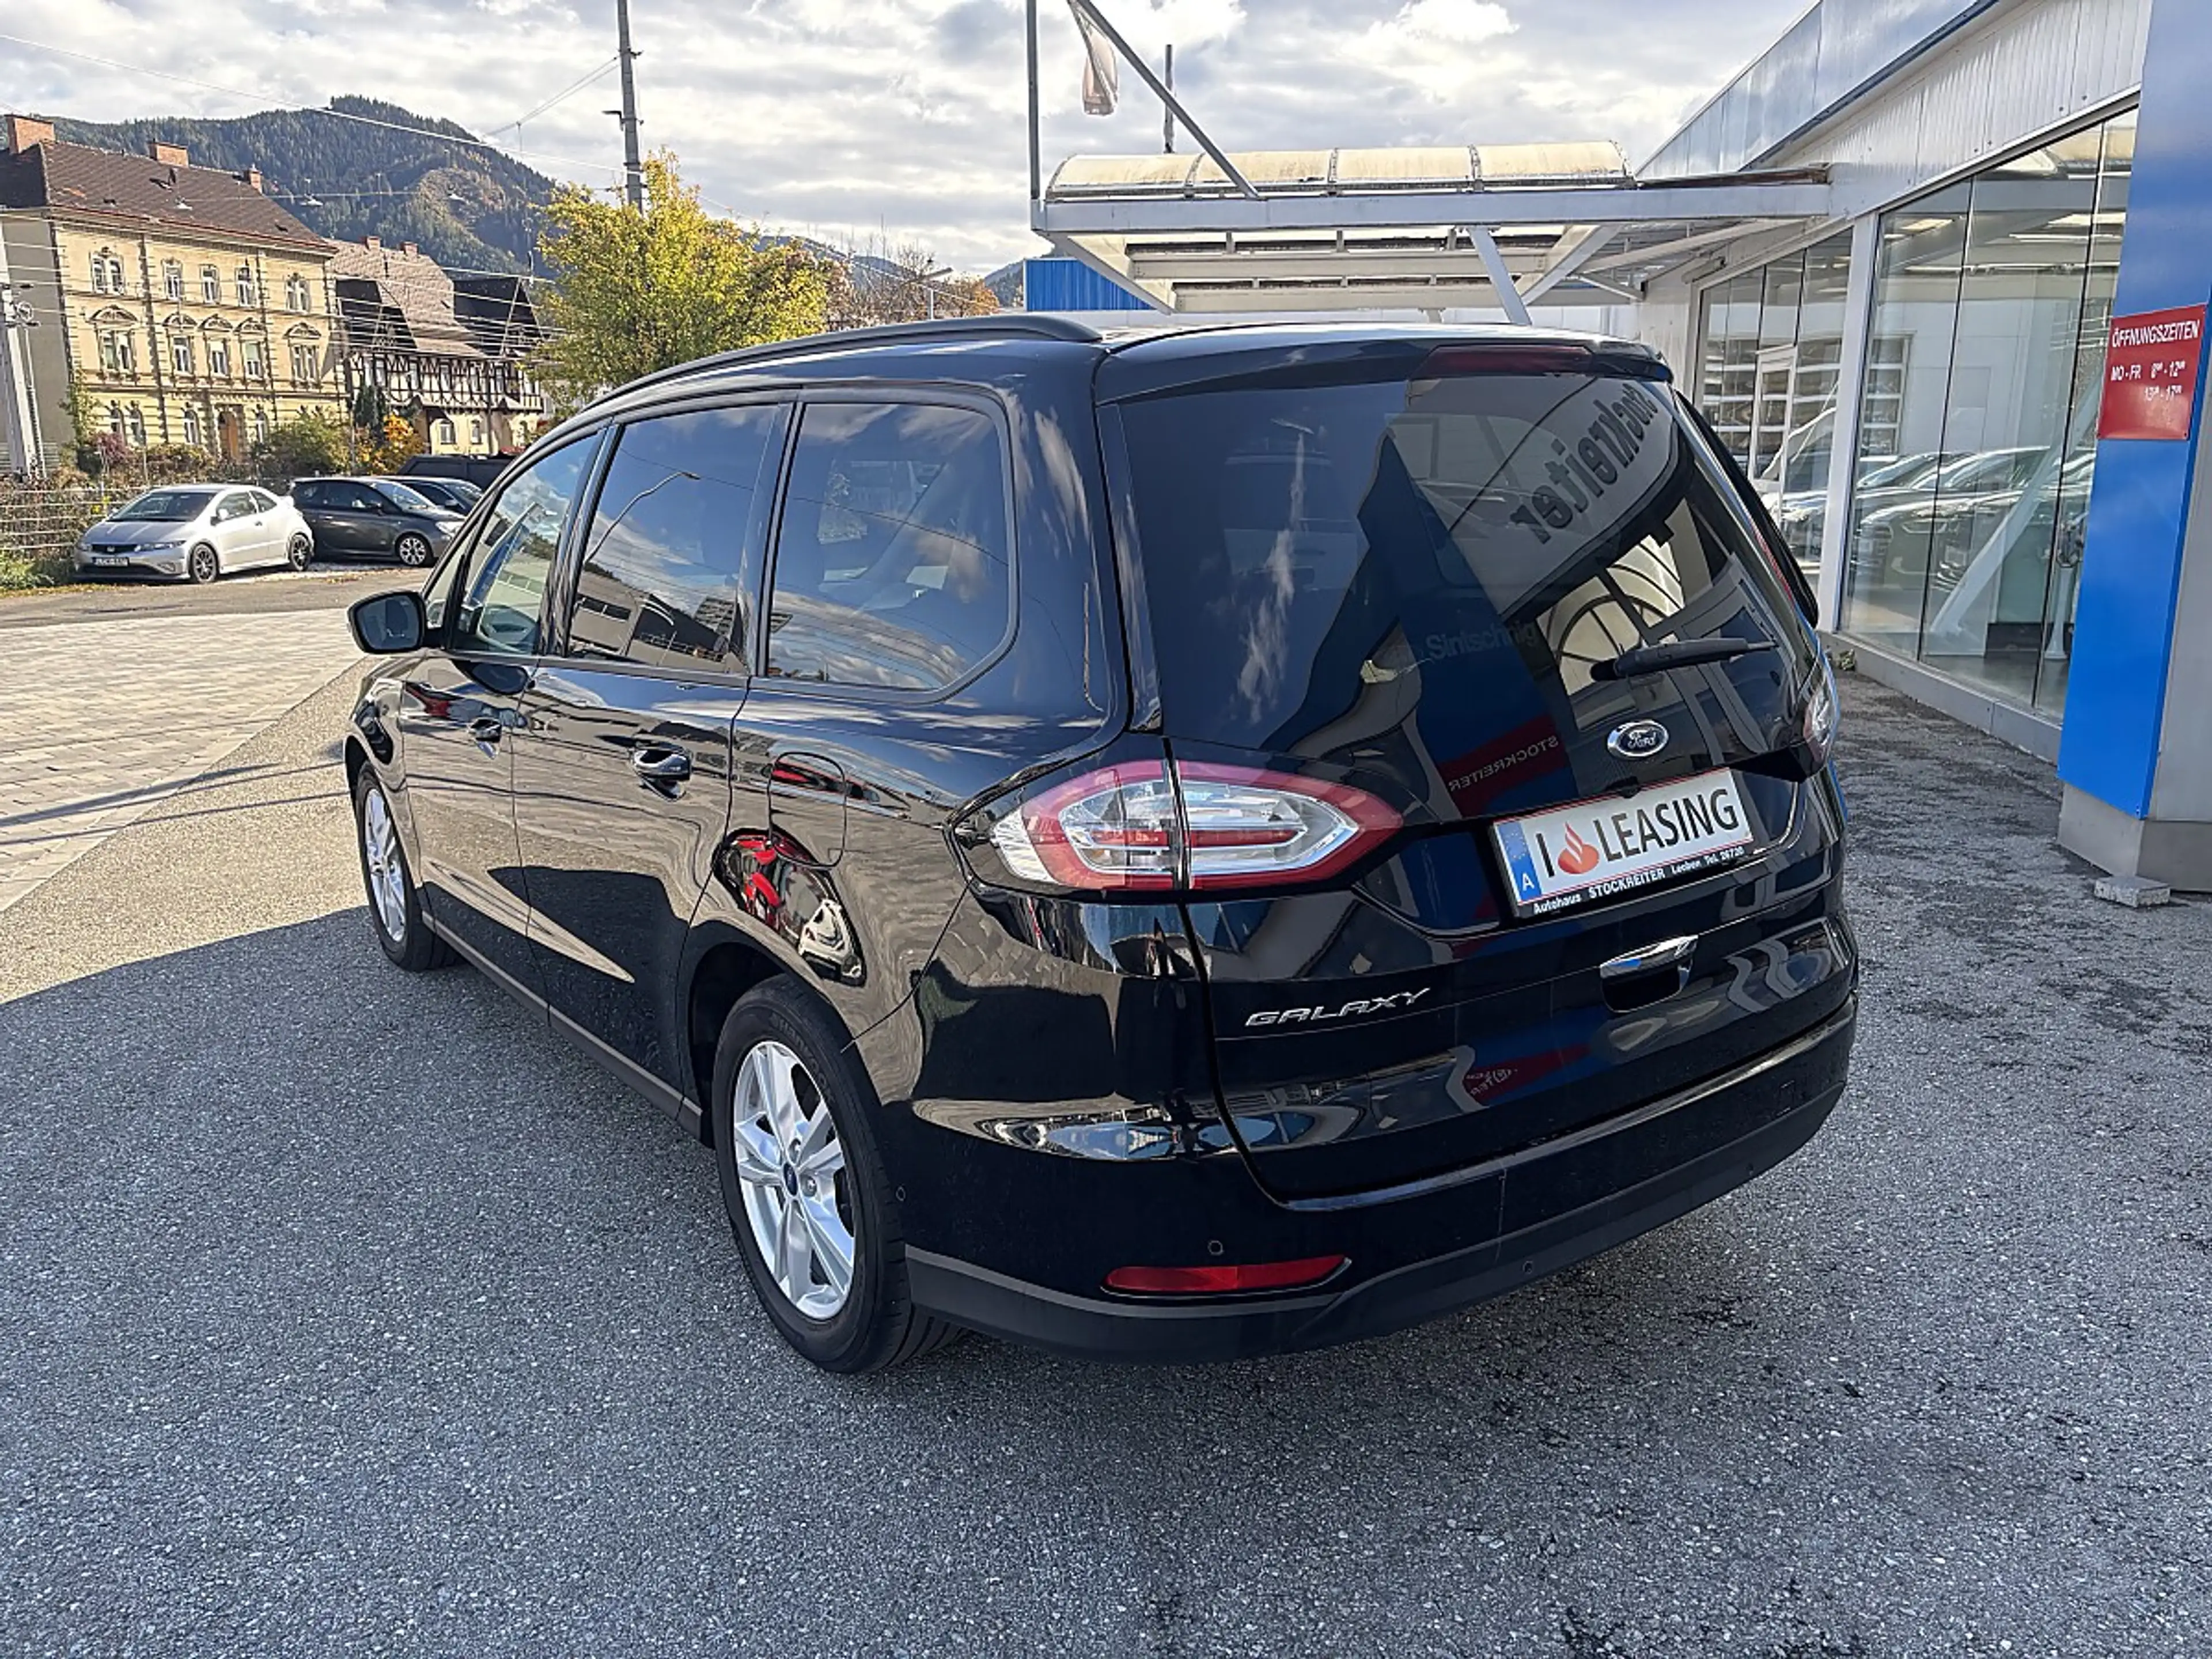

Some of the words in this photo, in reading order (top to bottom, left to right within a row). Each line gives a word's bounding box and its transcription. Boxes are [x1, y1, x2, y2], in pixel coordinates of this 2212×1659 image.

[2112, 319, 2200, 347] ÖFFNUNGSZEITEN
[1627, 728, 1657, 749] Ford
[1535, 832, 1555, 878] I
[1593, 789, 1739, 862] LEASING
[1521, 873, 1535, 891] A
[1533, 893, 1581, 915] Autohaus
[1588, 868, 1665, 899] STOCKREITER
[1244, 987, 1431, 1027] GALAXY
